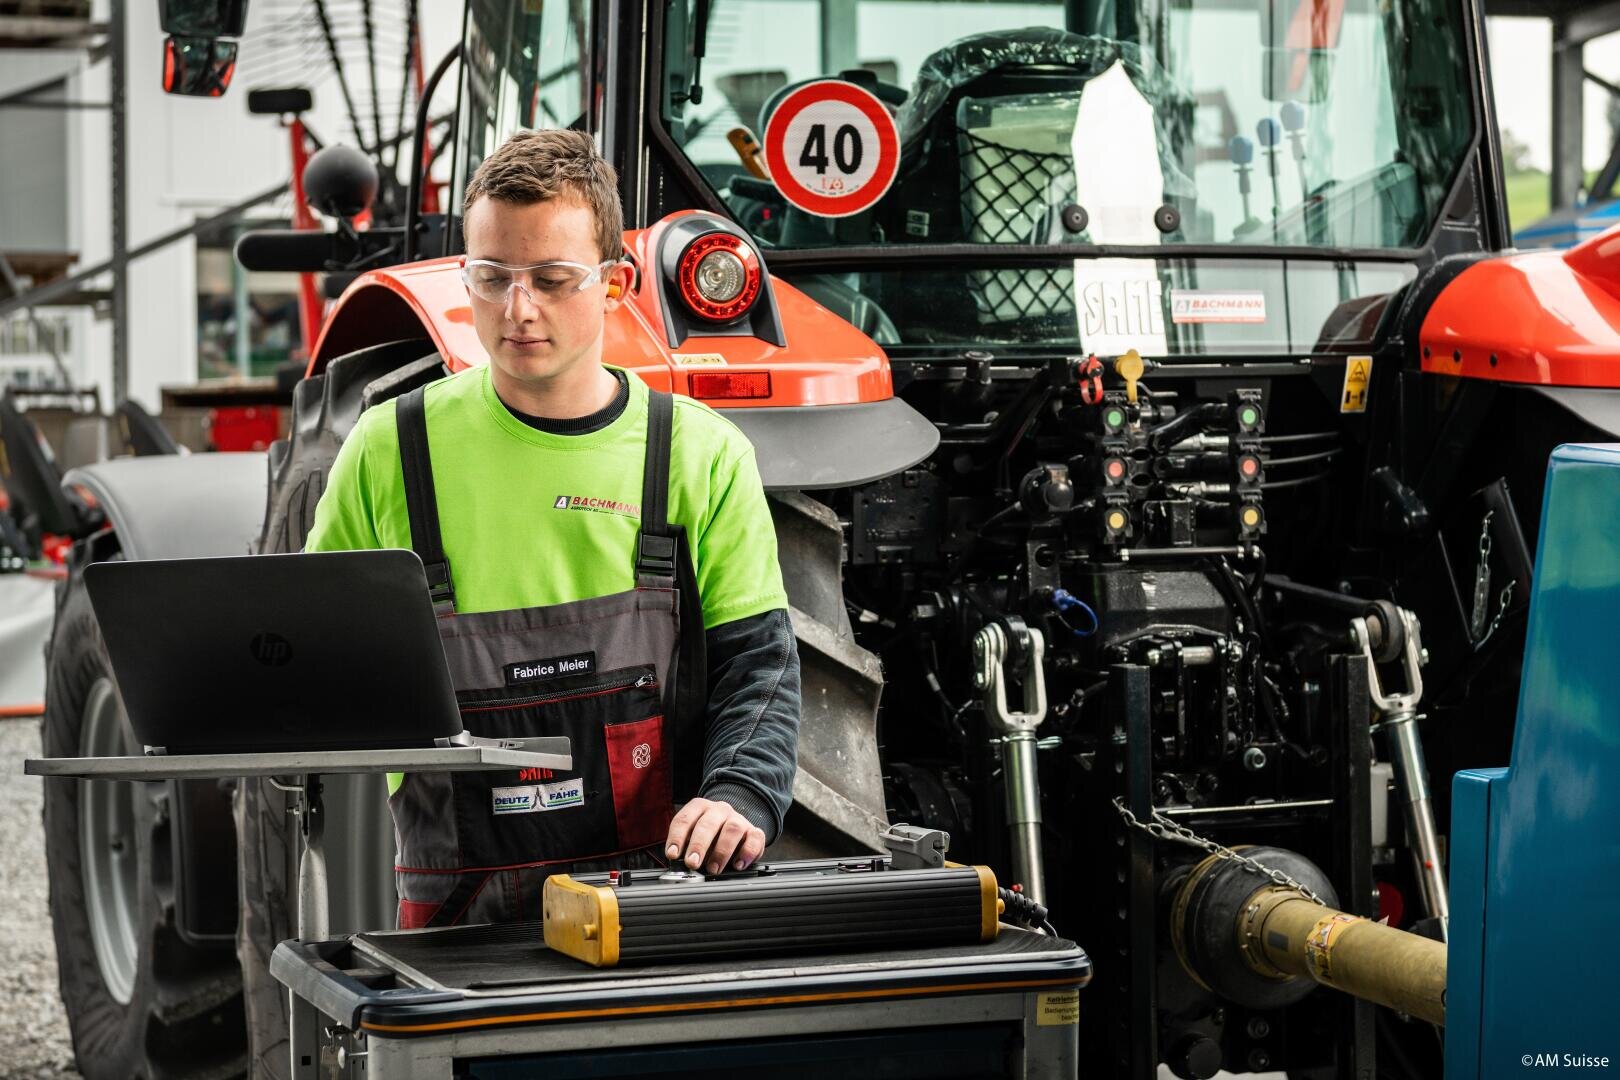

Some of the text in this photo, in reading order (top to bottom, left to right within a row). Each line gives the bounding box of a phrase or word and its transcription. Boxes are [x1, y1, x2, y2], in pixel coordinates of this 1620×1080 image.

[799, 124, 863, 175] 40
[1083, 280, 1165, 336] SAME
[1192, 300, 1262, 308] BACHMANN
[572, 496, 640, 515] BACHMANN
[256, 632, 288, 666] hp
[513, 659, 589, 679] Fabrice Meier
[494, 789, 578, 804] DEUTZ FAHR
